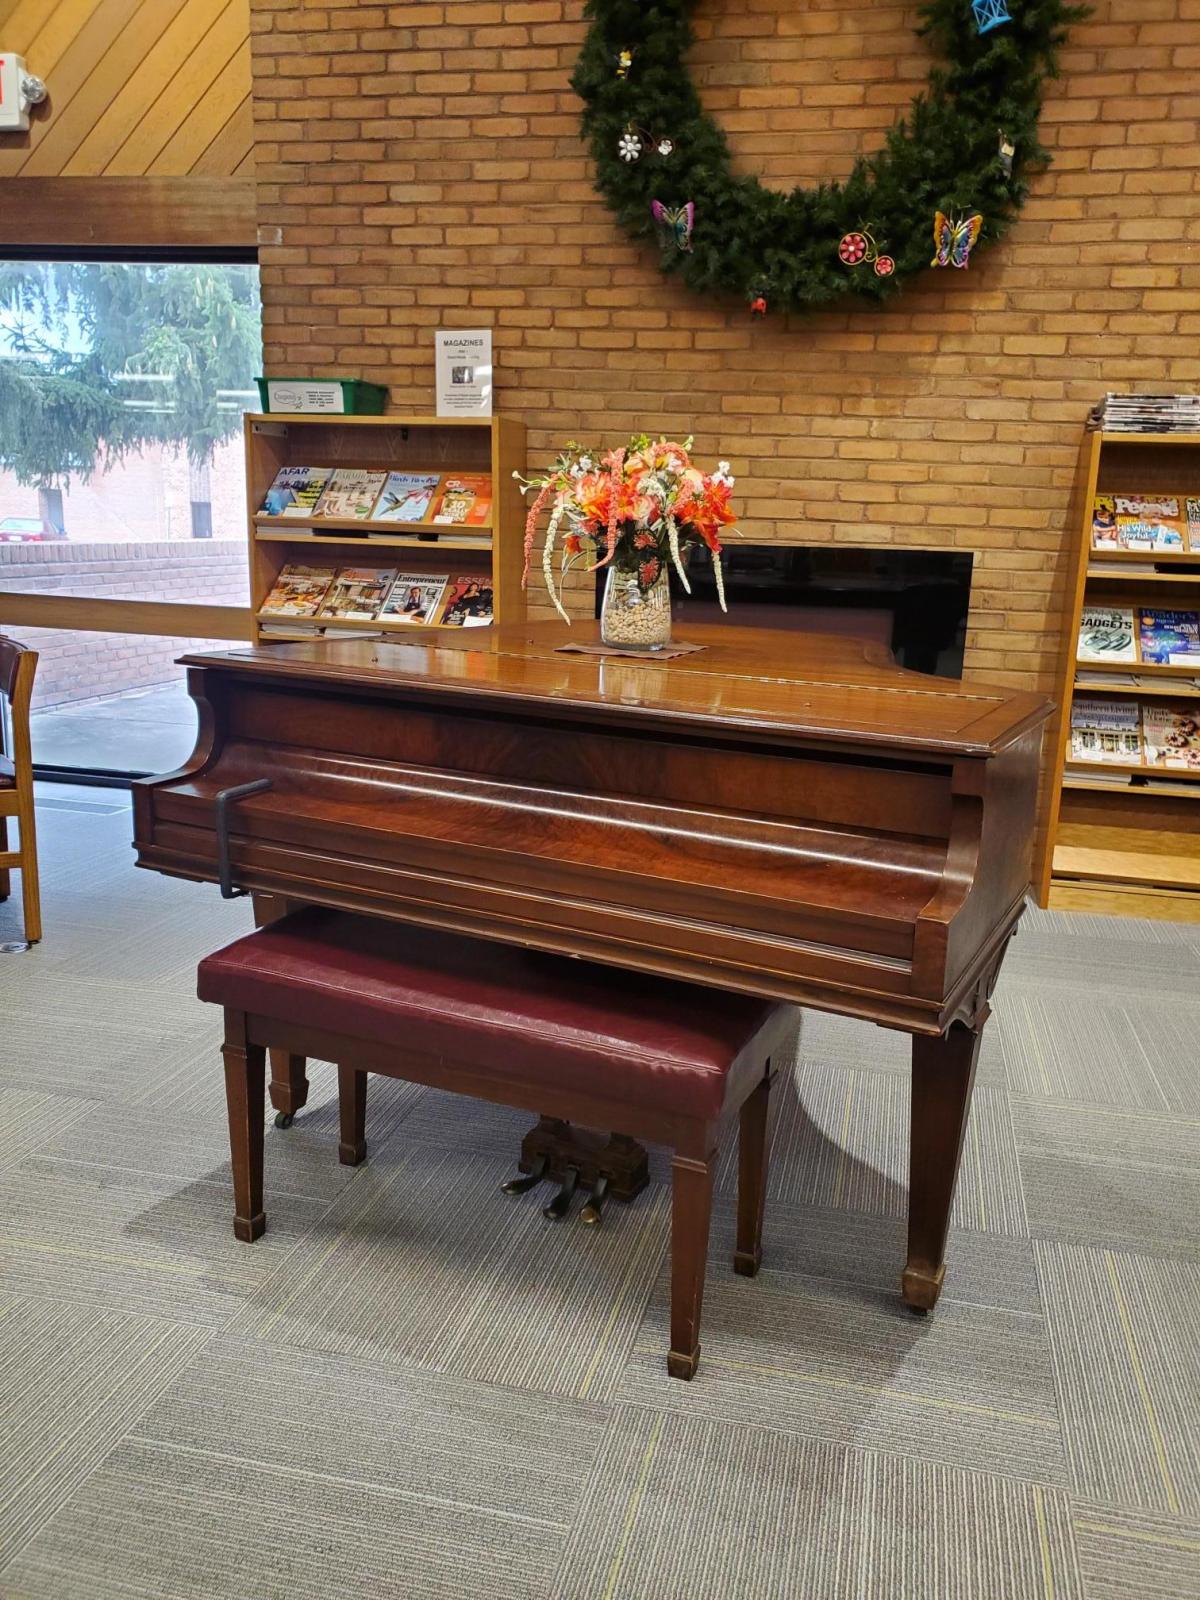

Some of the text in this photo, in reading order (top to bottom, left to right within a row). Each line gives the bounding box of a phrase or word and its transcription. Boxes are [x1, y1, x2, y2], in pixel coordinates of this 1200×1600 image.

[443, 339, 484, 347] MAGAZINES
[280, 467, 310, 475] AFAR
[1131, 524, 1152, 532] Wild
[397, 574, 448, 585] Entrepreneur
[1080, 618, 1133, 630] GADGETS
